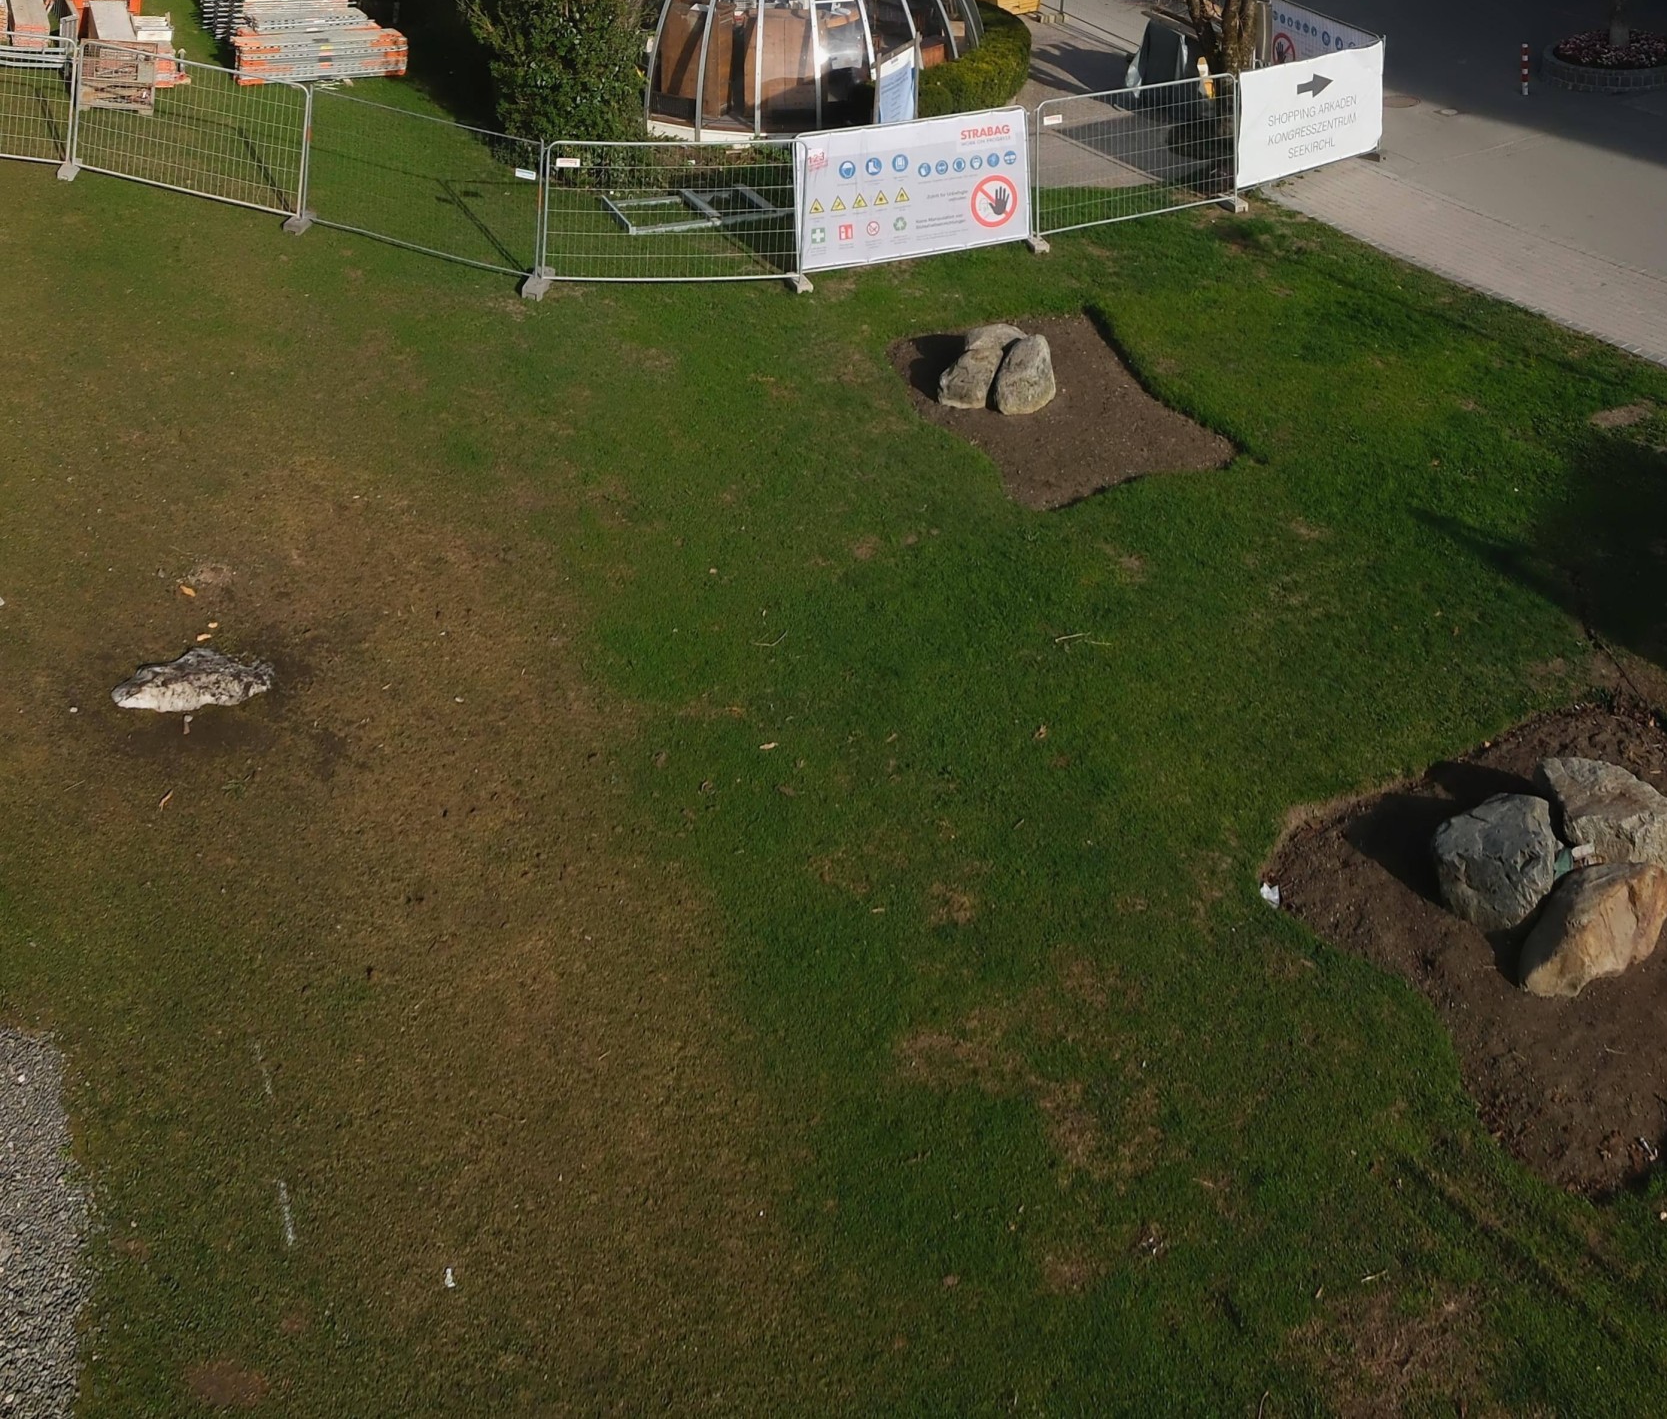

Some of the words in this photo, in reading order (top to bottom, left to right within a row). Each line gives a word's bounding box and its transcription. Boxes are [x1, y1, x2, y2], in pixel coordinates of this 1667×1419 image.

[1268, 105, 1316, 127] SHOPPING
[1317, 94, 1357, 115] ARKADEN
[961, 124, 1010, 140] STRABAG
[1268, 112, 1357, 146] KONGRESSZENTRUM
[1288, 137, 1336, 159] SEEKIRCHL
